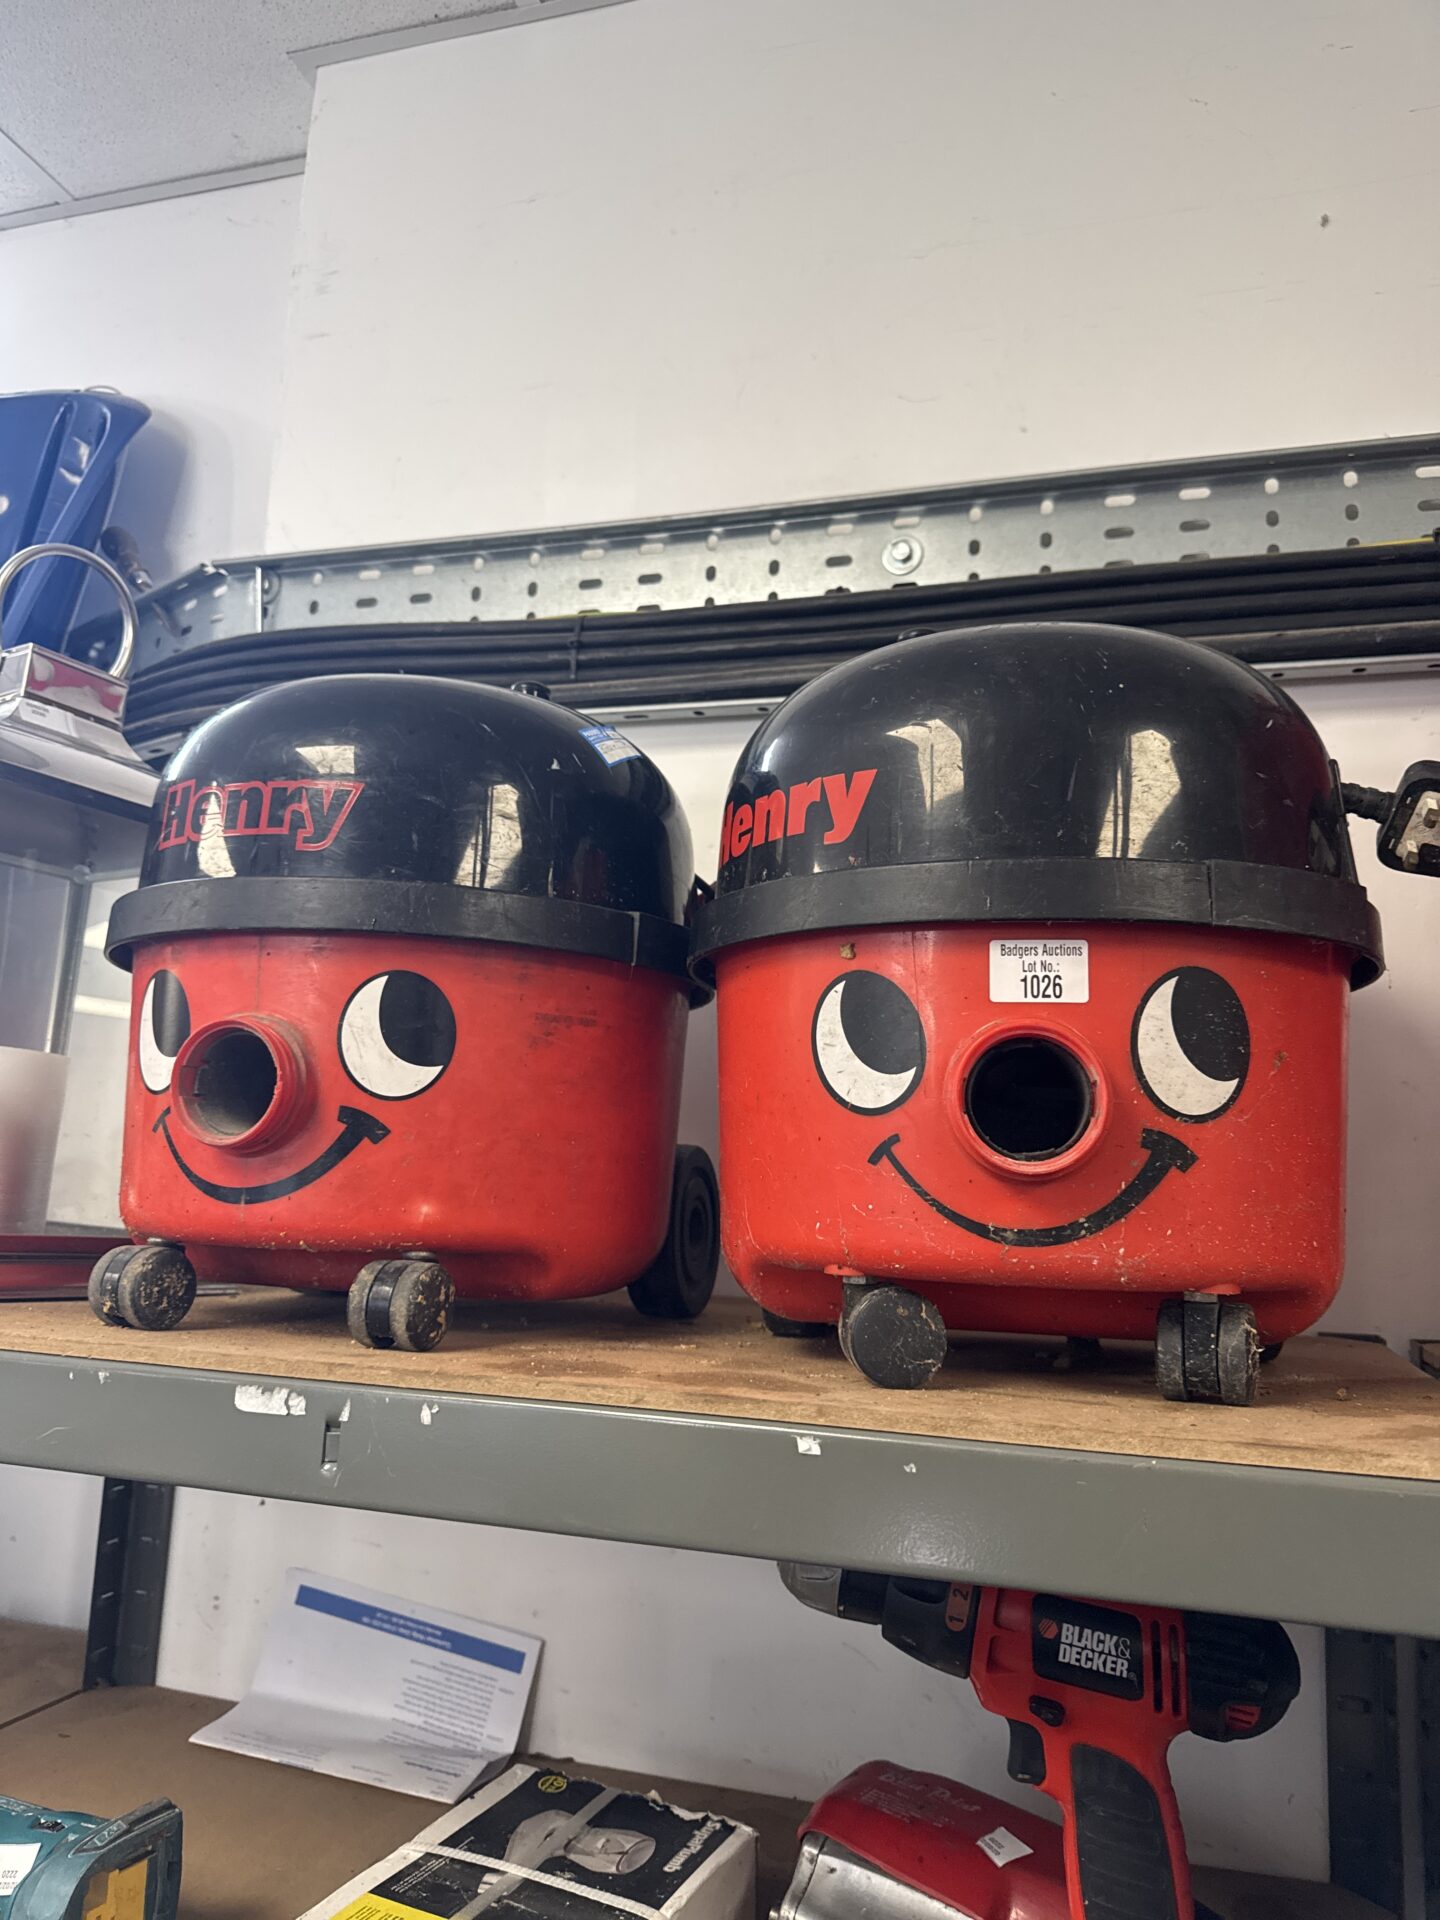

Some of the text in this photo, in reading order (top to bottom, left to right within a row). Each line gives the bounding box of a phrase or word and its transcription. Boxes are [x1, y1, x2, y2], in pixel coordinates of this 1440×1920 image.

[157, 778, 365, 851] Henry
[722, 768, 878, 867] Henry
[1000, 943, 1083, 959] Badgers Auctions
[1022, 960, 1060, 973] Lot No.:
[1020, 974, 1063, 999] 1026
[1058, 1643, 1129, 1678] DECKER
